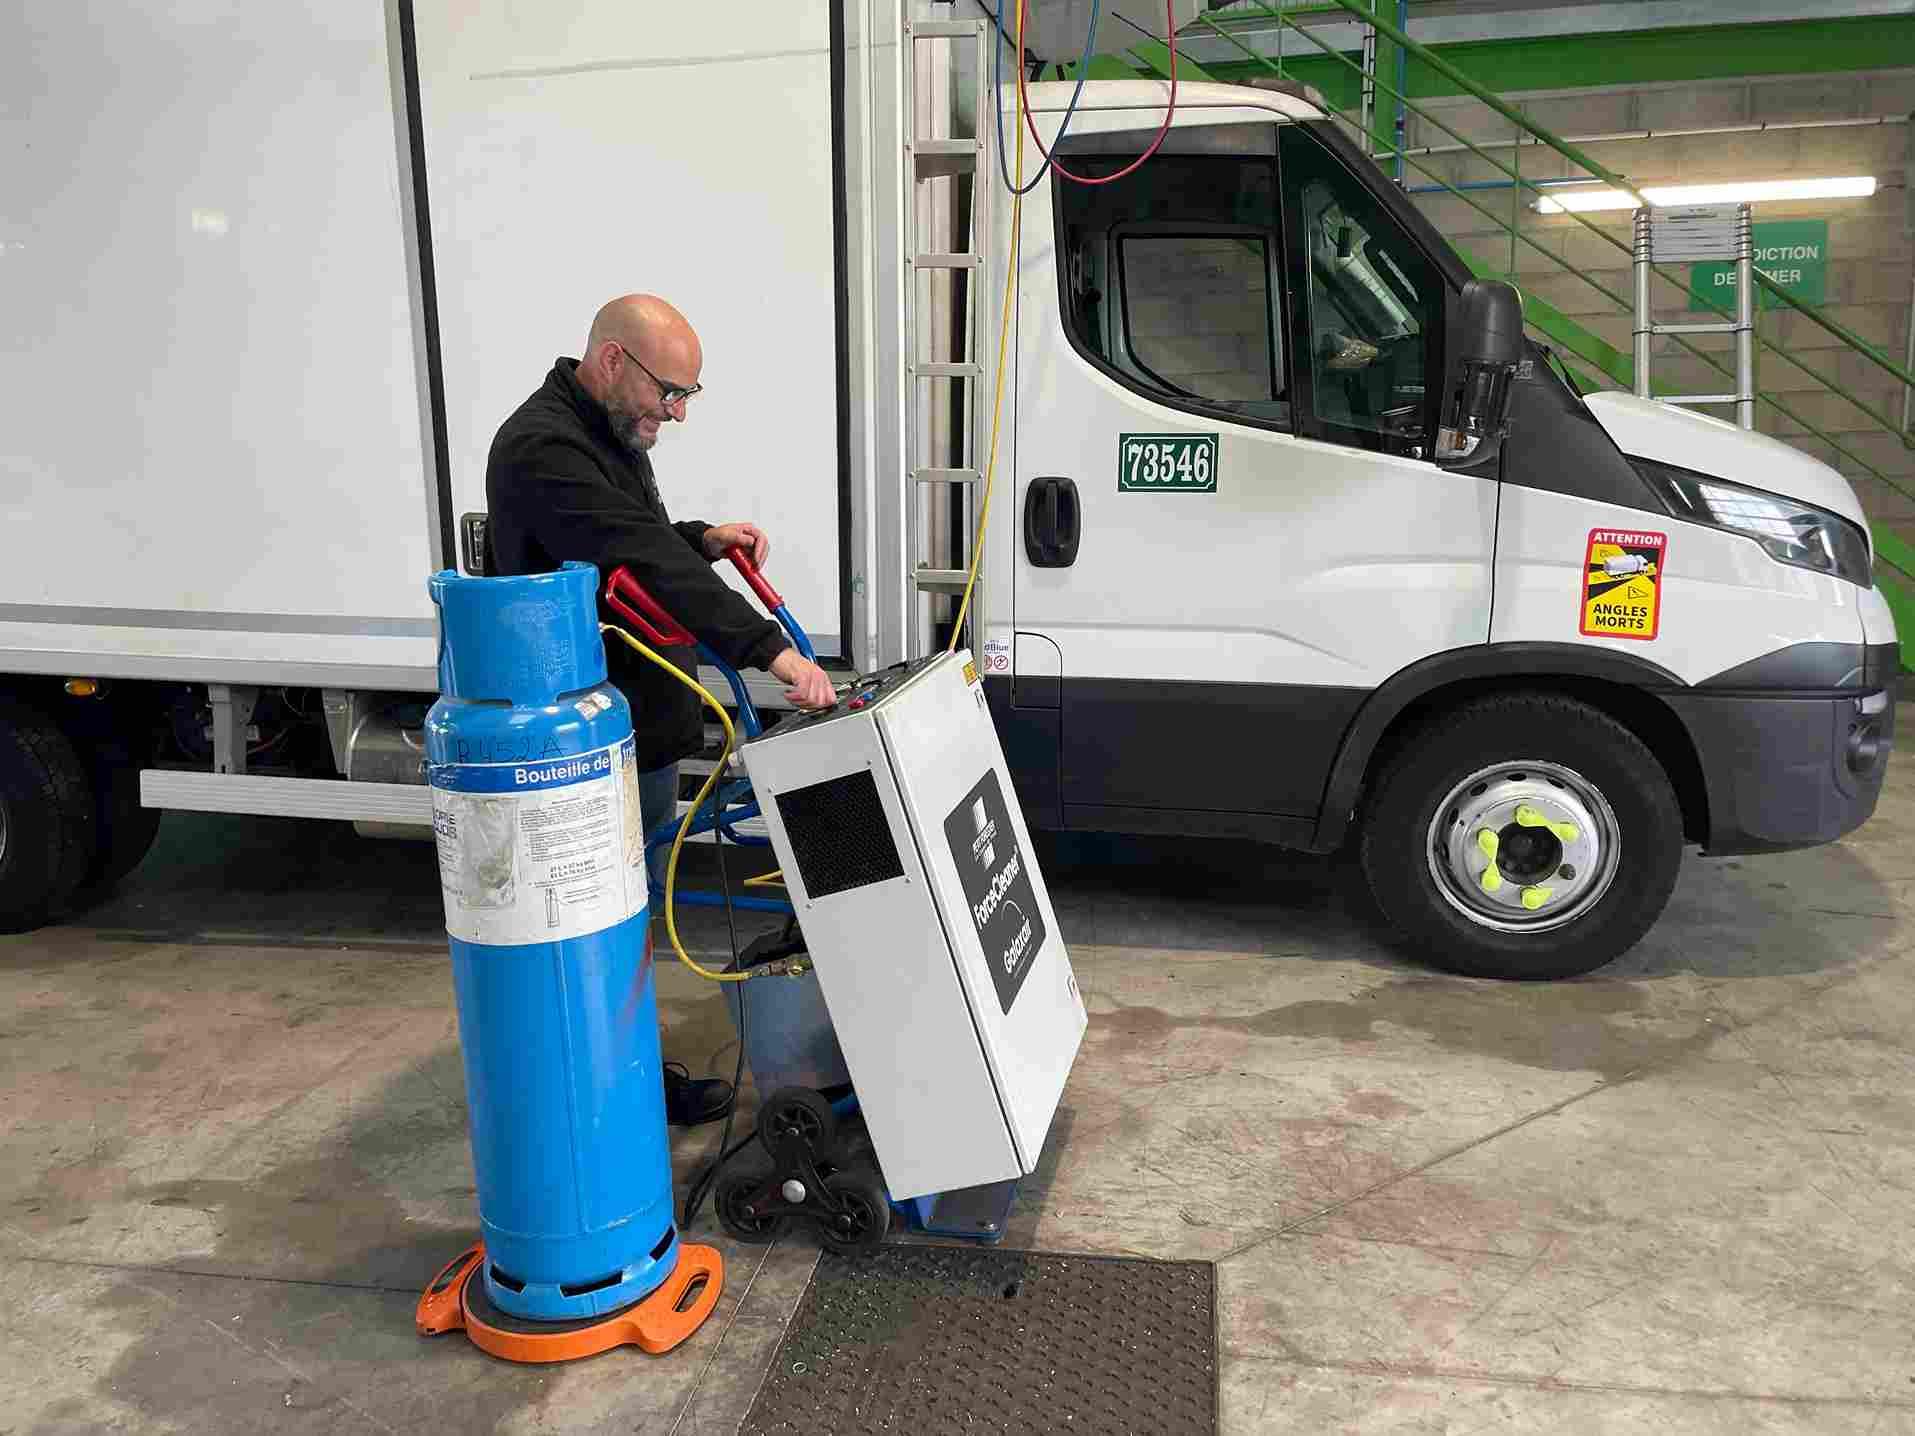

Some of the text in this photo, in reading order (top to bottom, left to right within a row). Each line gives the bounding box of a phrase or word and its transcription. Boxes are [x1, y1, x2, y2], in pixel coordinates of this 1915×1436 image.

[1752, 246, 1818, 261] DICTION
[1127, 443, 1209, 482] 73546
[1593, 532, 1662, 545] ATTENTION
[1593, 603, 1647, 617] ANGLES
[1595, 615, 1644, 629] MORTS
[984, 643, 1008, 651] dBlue
[515, 757, 609, 784] Bouteille de
[974, 853, 1020, 930] ForceCleaner
